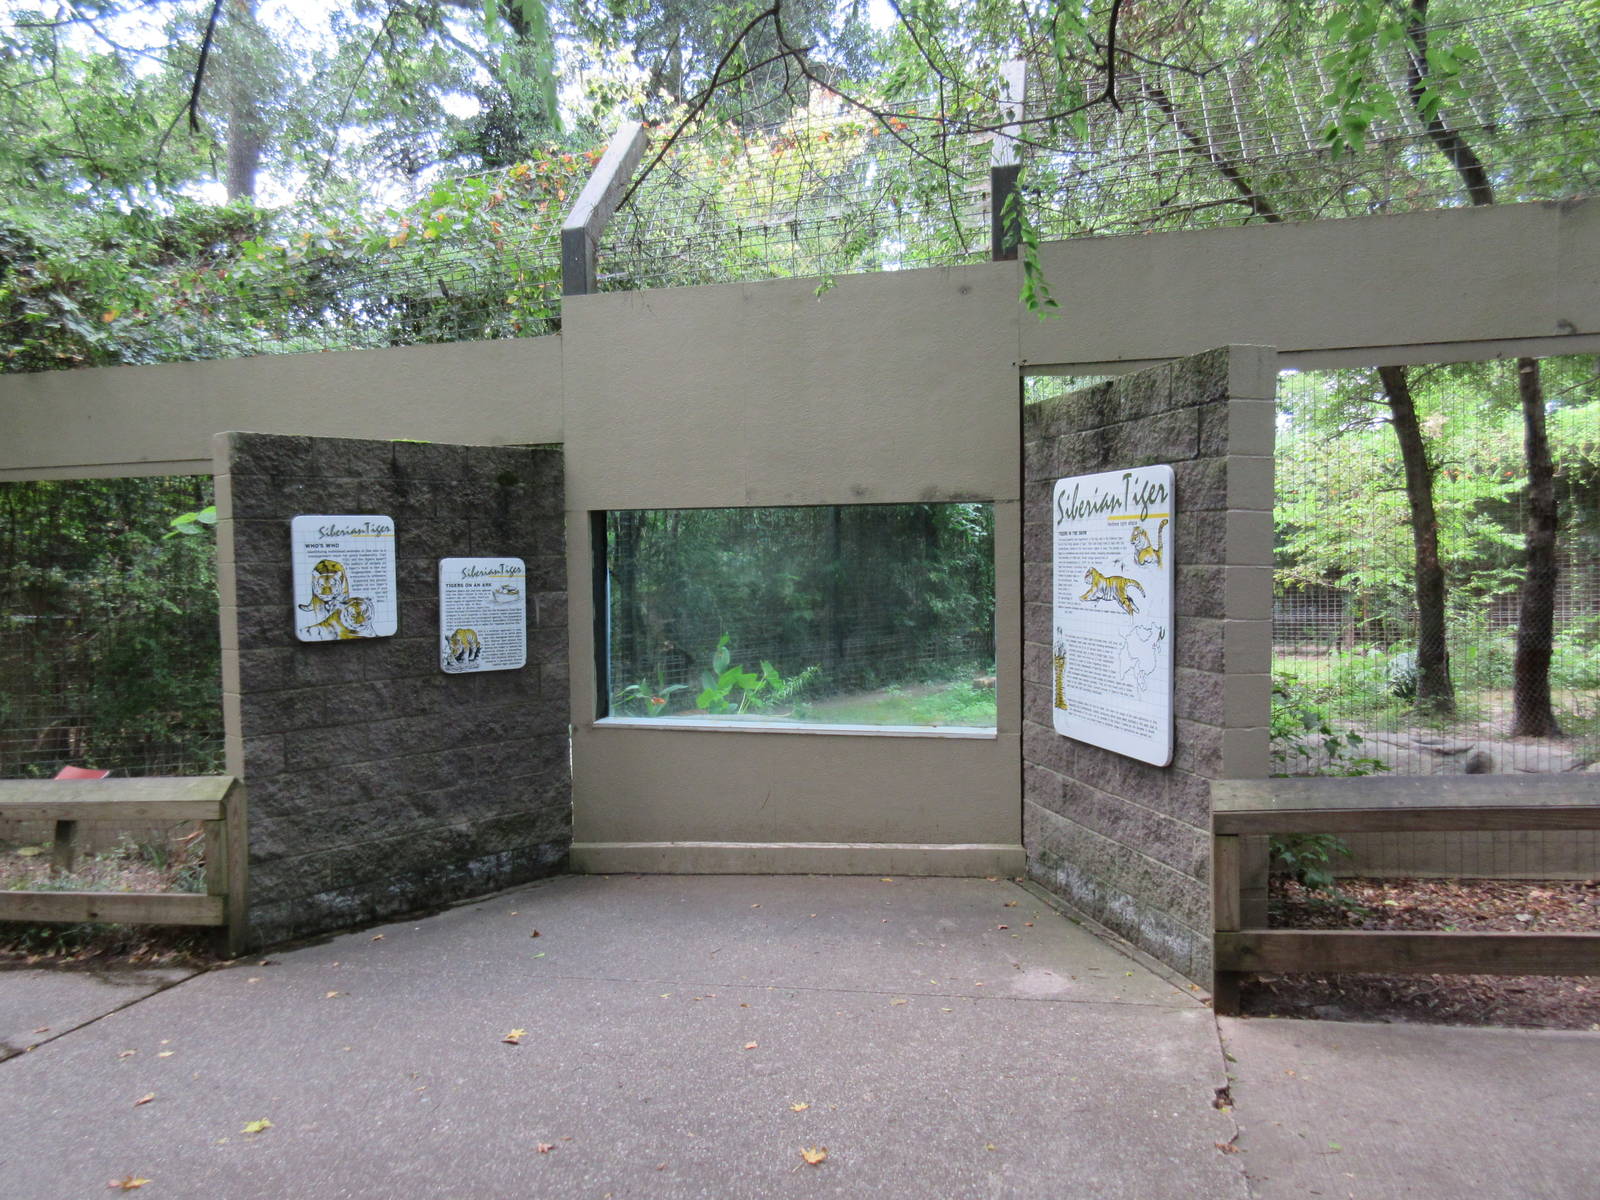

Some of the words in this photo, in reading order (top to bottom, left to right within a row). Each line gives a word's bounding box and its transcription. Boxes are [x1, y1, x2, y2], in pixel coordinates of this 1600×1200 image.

[1057, 483, 1122, 526] Siberian
[1122, 472, 1168, 521] Tiger
[319, 524, 364, 539] Siberian
[364, 522, 391, 537] Tiger
[462, 565, 500, 580] Siberian
[500, 563, 522, 578] Tiger
